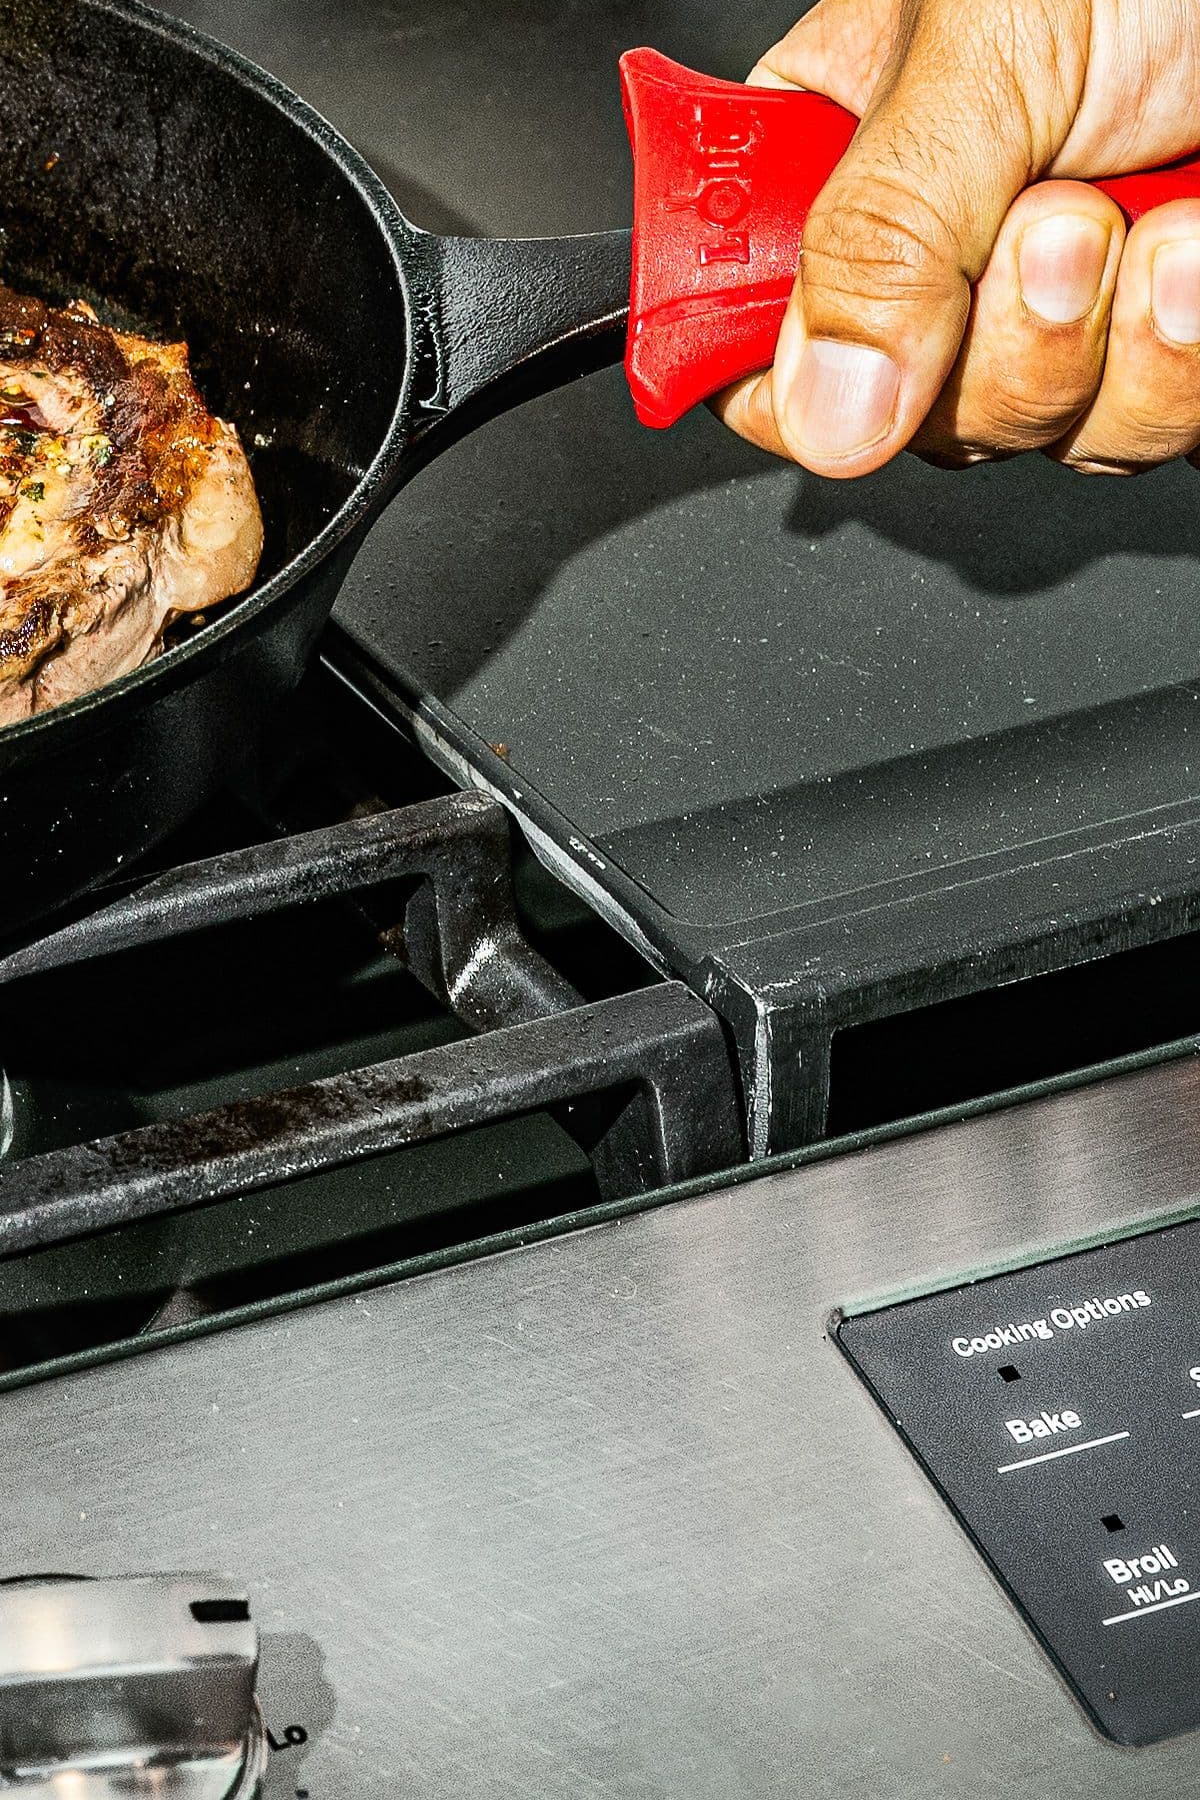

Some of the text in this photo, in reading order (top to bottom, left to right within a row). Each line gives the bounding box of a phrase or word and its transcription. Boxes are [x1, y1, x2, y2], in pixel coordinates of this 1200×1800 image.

[952, 1289, 1152, 1358] Cooking Options
[1006, 1409, 1083, 1445] Bake
[1103, 1545, 1179, 1584] Broil
[1127, 1577, 1190, 1607] Hi/Lo
[266, 1725, 308, 1752] Lo
